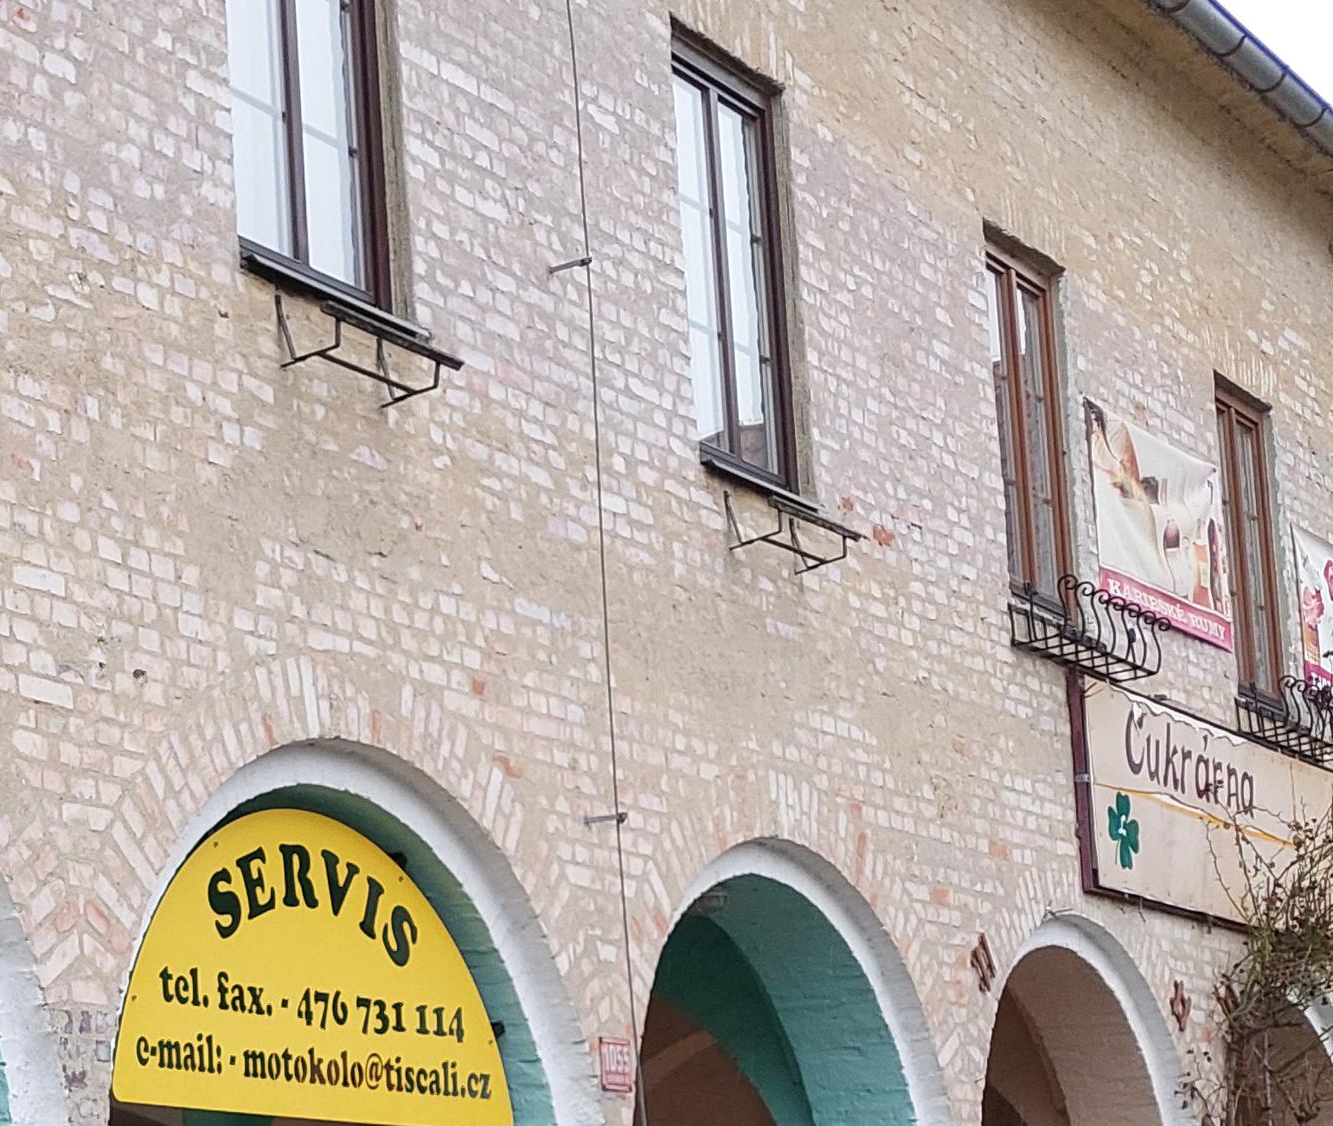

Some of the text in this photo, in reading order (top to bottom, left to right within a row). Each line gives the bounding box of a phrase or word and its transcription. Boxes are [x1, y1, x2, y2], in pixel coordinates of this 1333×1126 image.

[1125, 705, 1254, 816] Cukrárna
[208, 844, 417, 967] SERVIS
[159, 967, 209, 1007] tel.
[218, 972, 273, 1016] fax.
[298, 989, 348, 1029] 476
[356, 996, 406, 1035] 731
[416, 1005, 464, 1042] 114
[137, 1034, 222, 1074] e-mail:
[243, 1048, 491, 1099] motokolo@tiscali.cz
